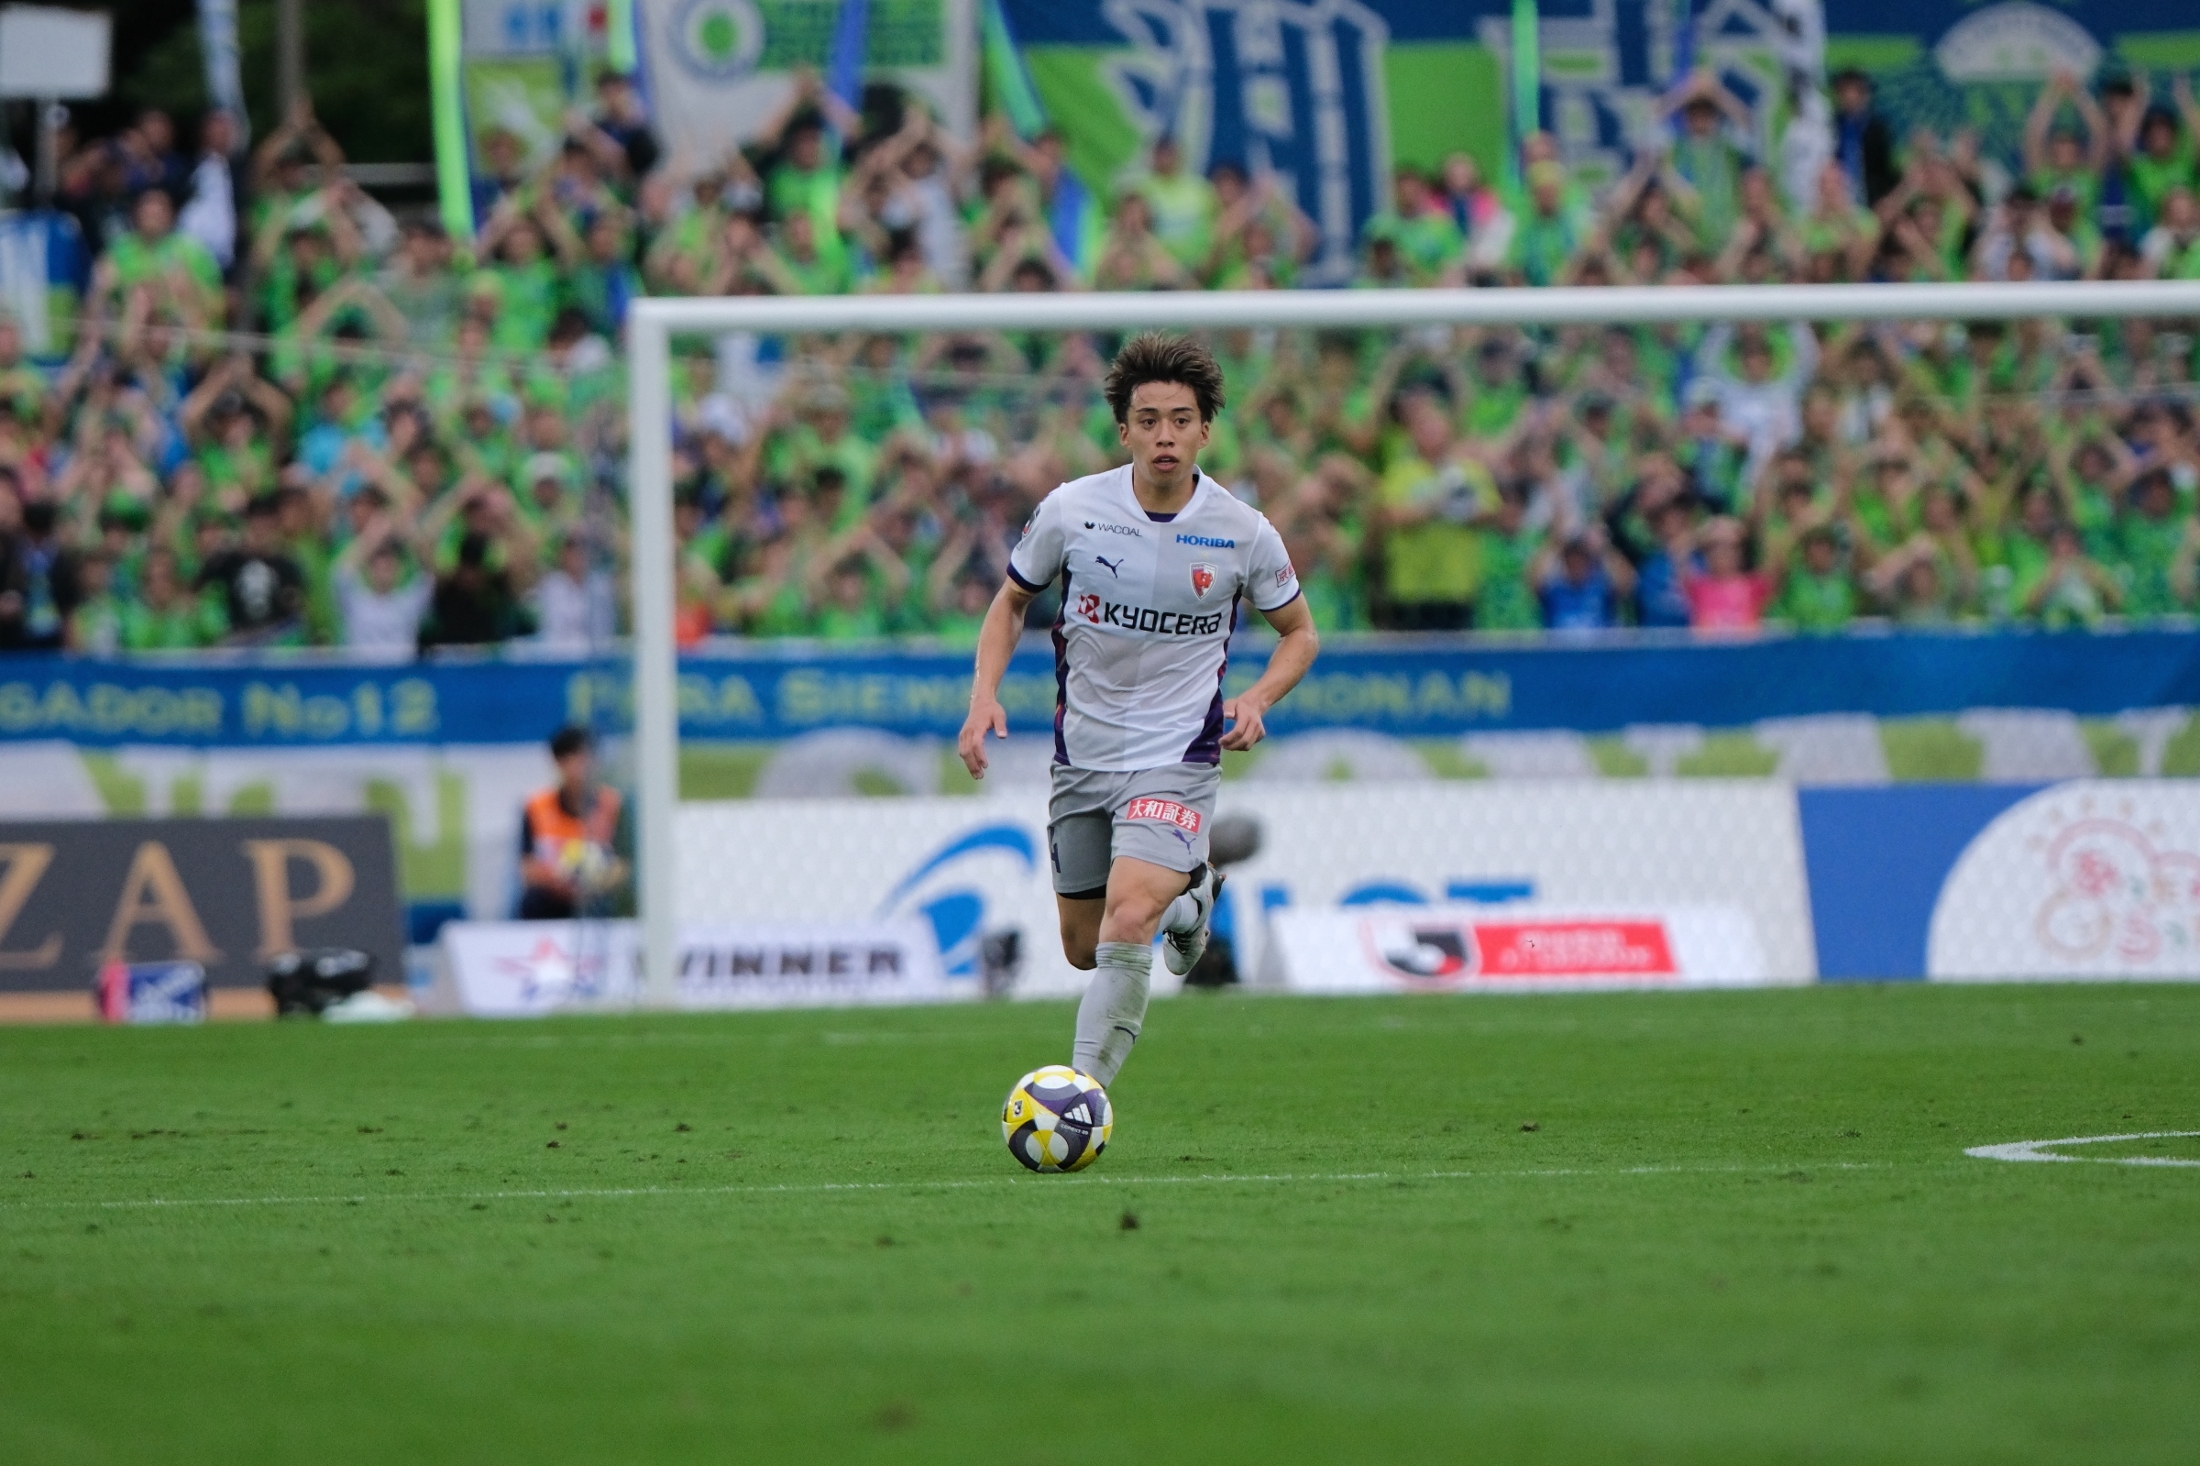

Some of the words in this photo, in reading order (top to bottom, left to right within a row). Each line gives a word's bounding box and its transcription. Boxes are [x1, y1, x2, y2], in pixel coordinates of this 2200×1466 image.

[1098, 522, 1143, 537] WACOAL
[1175, 533, 1235, 549] HORIBA
[1104, 602, 1223, 635] KYOCERA
[1129, 800, 1197, 830] 大和証券
[0, 839, 358, 970] ZAP
